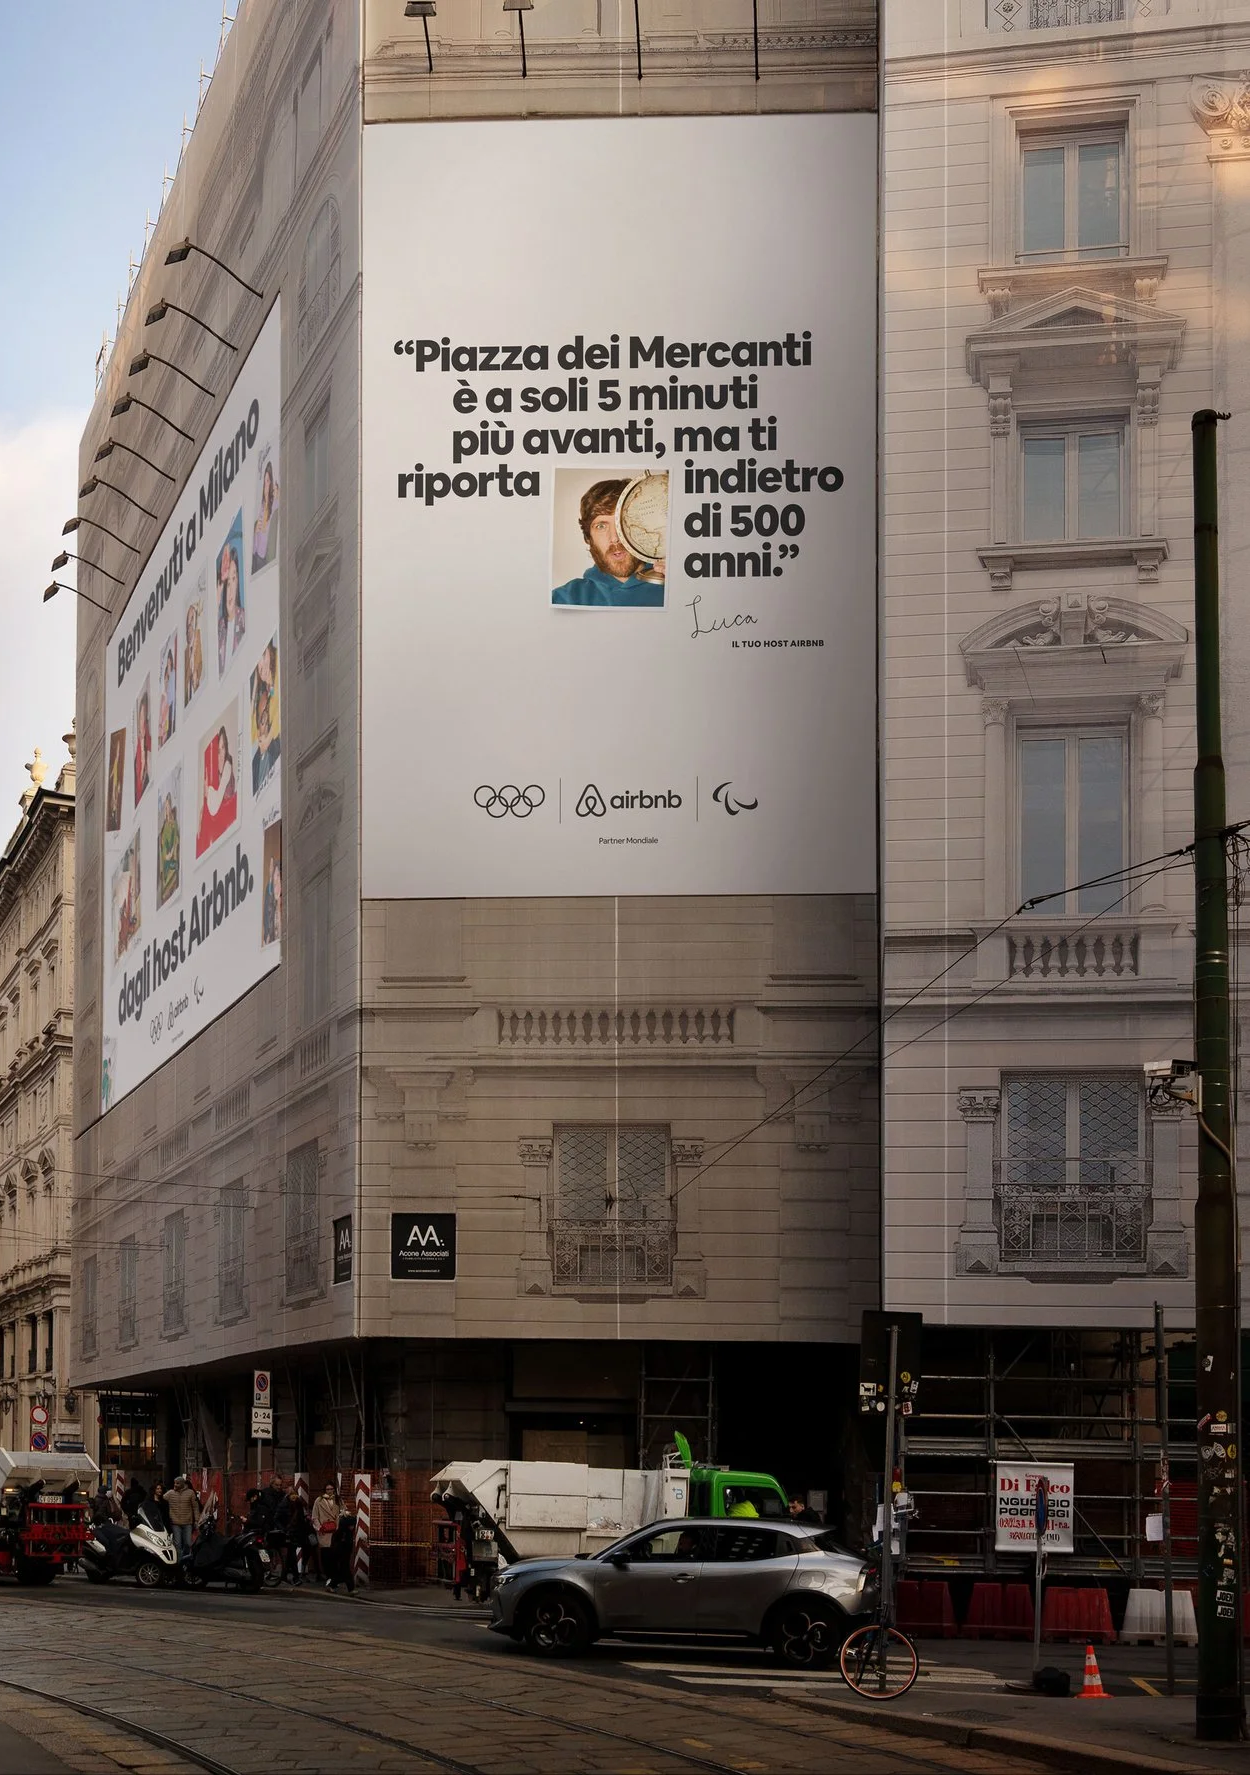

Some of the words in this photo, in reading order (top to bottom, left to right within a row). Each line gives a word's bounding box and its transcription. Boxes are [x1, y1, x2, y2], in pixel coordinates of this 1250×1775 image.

[394, 336, 549, 372] “Piazza
[558, 334, 620, 371] dei
[630, 331, 812, 369] Mercanti
[452, 379, 478, 414] è
[486, 387, 512, 414] a
[521, 377, 588, 412] soli
[598, 379, 622, 412] 5
[630, 374, 758, 411] minuti
[452, 420, 514, 464] più
[523, 418, 666, 460] avanti,
[674, 426, 740, 452] ma
[748, 415, 778, 452] ti
[398, 463, 540, 506] riporta
[684, 458, 845, 494] indietro
[684, 502, 722, 538] di
[729, 503, 806, 538] 500
[117, 521, 184, 688] Benvenuti
[185, 512, 197, 562] a
[199, 398, 260, 541] Milano
[683, 542, 800, 579] anni.”
[685, 594, 759, 639] Luca
[731, 640, 740, 648] IL
[741, 640, 762, 648] TUO
[763, 640, 789, 648] HOST
[790, 639, 825, 648] AIRBNB
[610, 789, 683, 810] airbnb
[598, 837, 626, 845] Partner
[626, 836, 659, 845] Mondiale
[117, 945, 151, 1026] dagli
[152, 909, 186, 991] host
[187, 842, 255, 957] Airbnb.
[421, 1249, 450, 1258] Associati
[1000, 1478, 1020, 1492] Di
[1025, 1479, 1071, 1495] Flco
